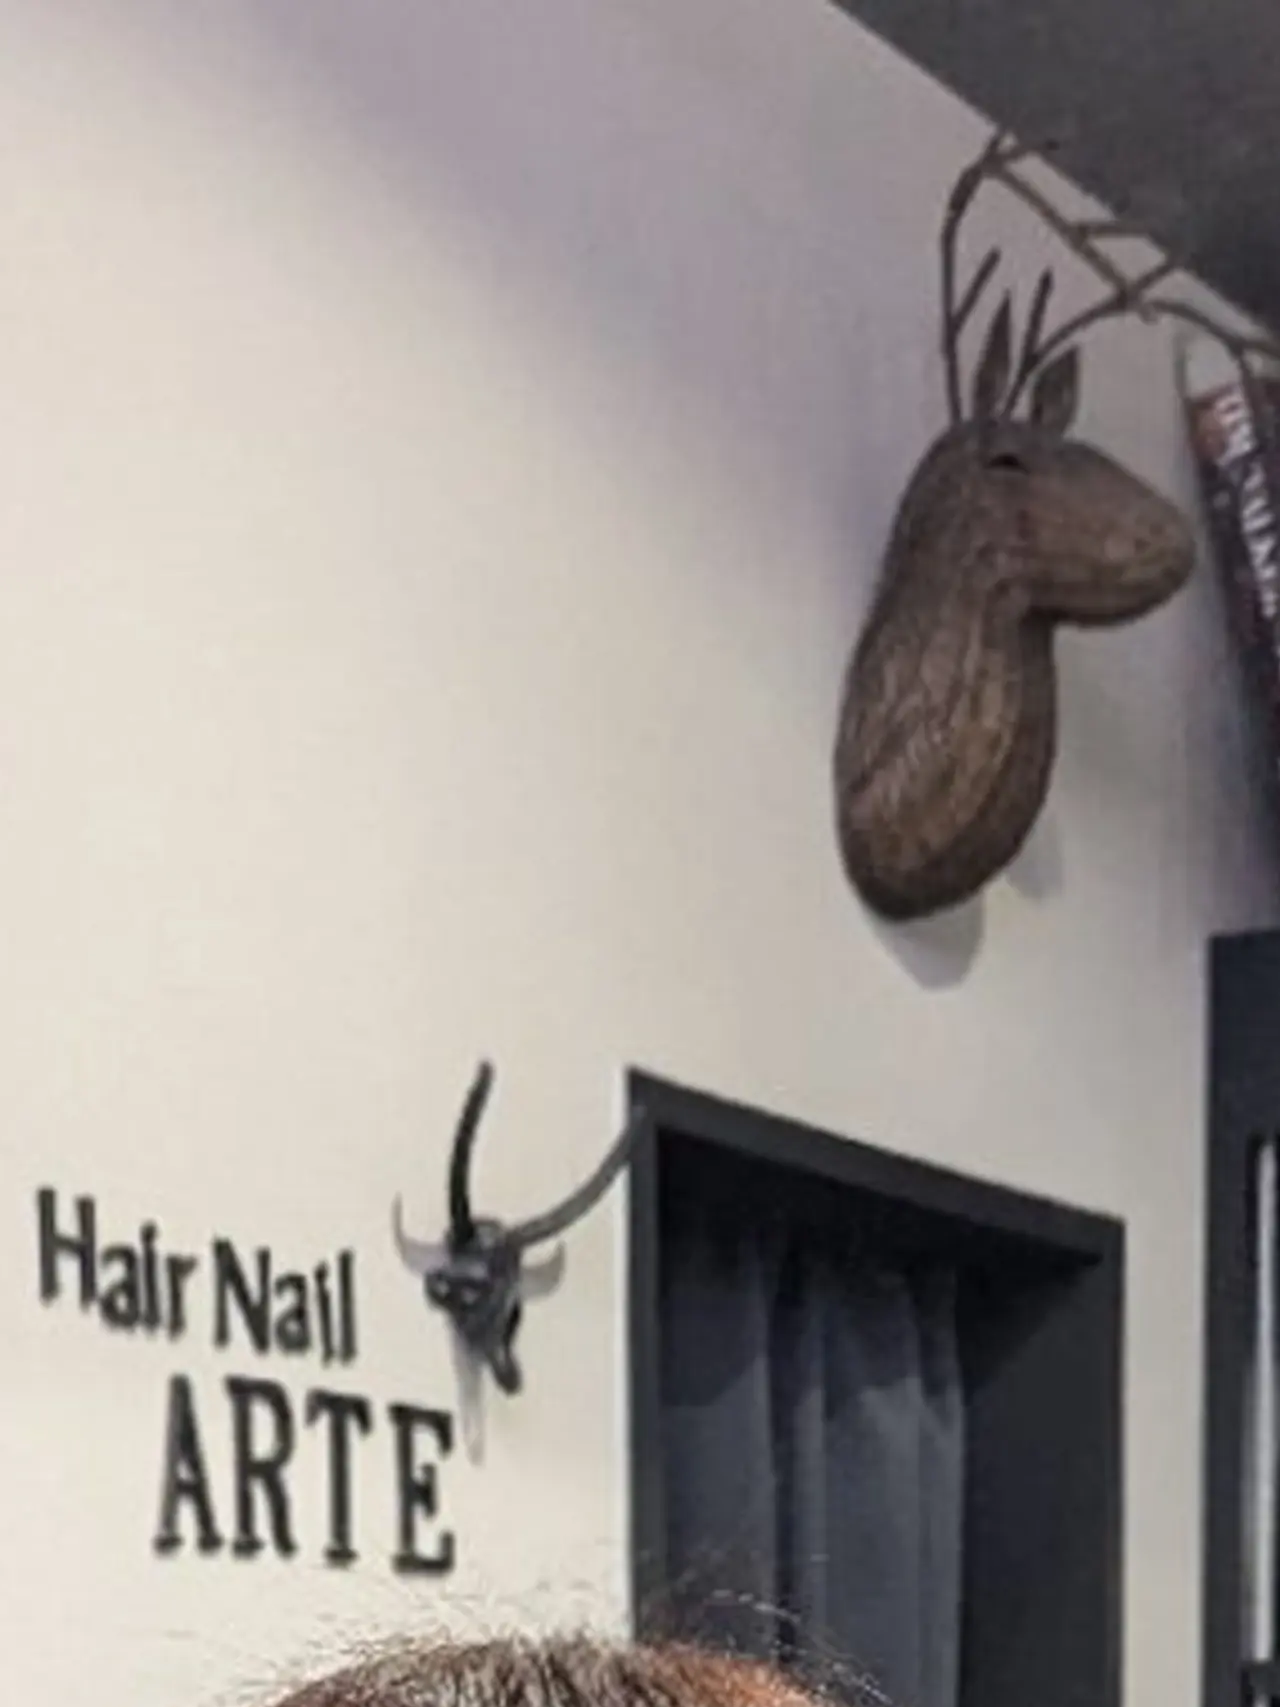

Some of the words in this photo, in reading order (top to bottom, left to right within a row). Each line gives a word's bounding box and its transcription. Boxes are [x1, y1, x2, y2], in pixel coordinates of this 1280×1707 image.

[36, 1186, 196, 1342] Hair
[212, 1236, 358, 1366] Nail
[153, 1372, 457, 1578] ARTE
